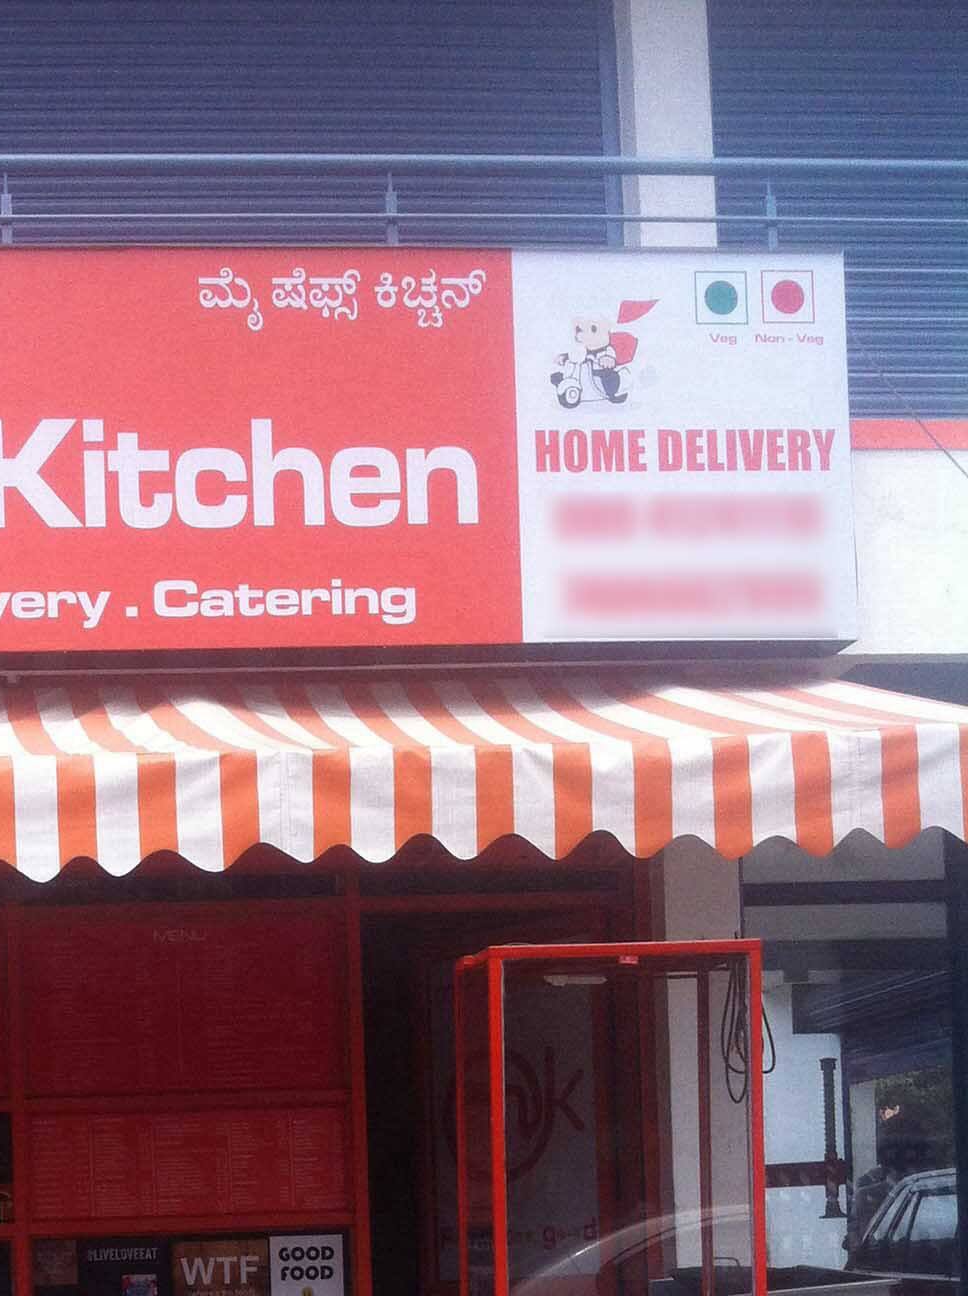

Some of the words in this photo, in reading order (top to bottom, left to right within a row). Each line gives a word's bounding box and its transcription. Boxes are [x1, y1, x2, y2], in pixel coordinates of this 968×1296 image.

[199, 268, 264, 331] ಮೈ
[709, 333, 737, 346] Veg
[535, 430, 647, 474] HOME
[656, 430, 836, 473] DELIVERY
[154, 578, 418, 626] Catering
[152, 927, 209, 944] MENU
[278, 1246, 335, 1262] GOOD
[179, 1255, 260, 1286] WTF
[280, 1265, 334, 1281] FOOD
